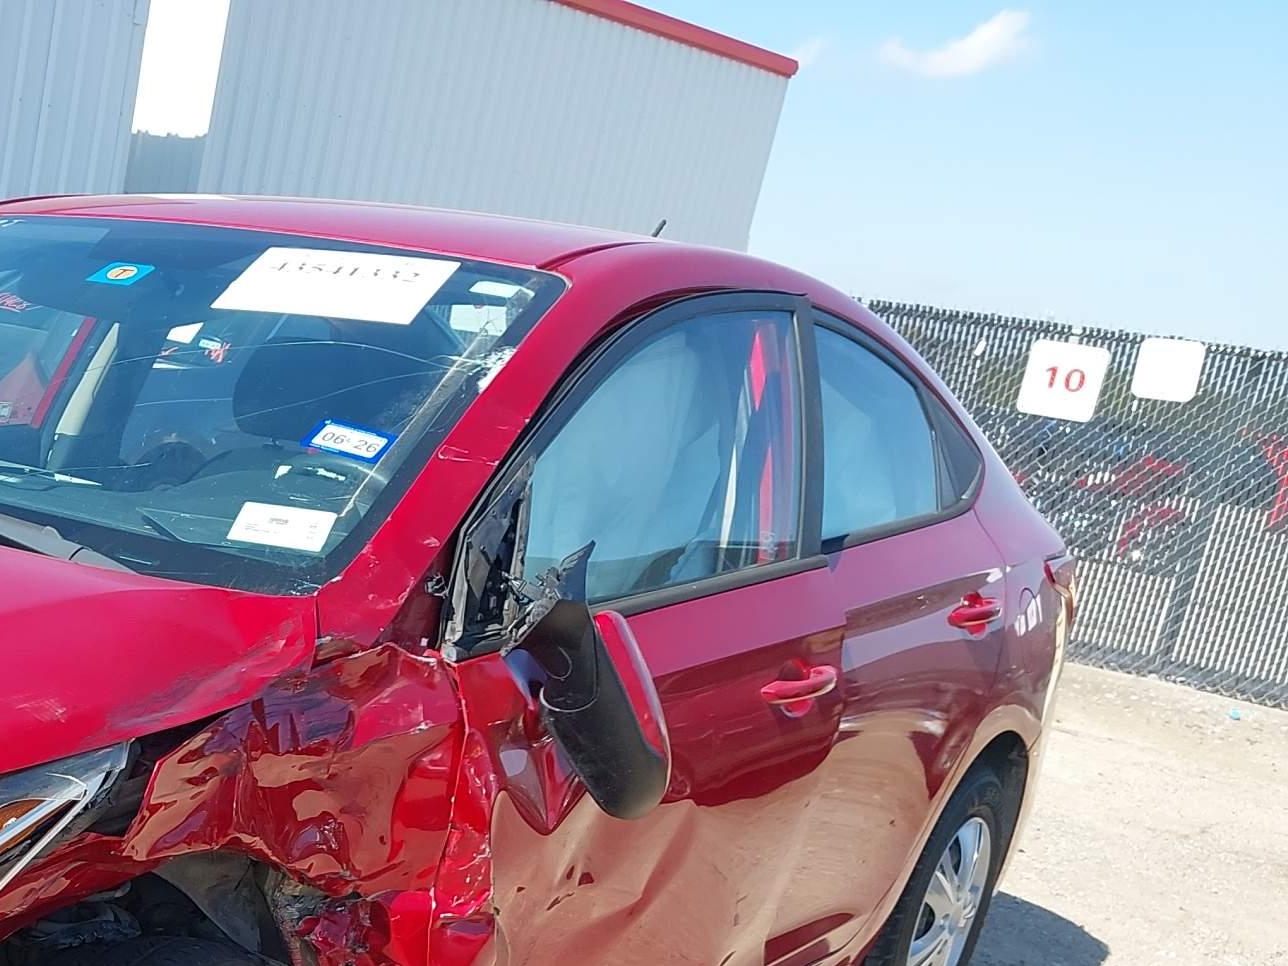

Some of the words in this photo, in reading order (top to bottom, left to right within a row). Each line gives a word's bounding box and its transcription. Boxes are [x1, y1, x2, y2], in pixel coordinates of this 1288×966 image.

[1044, 366, 1086, 393] 10
[321, 431, 348, 445] 06
[352, 439, 381, 454] 26
